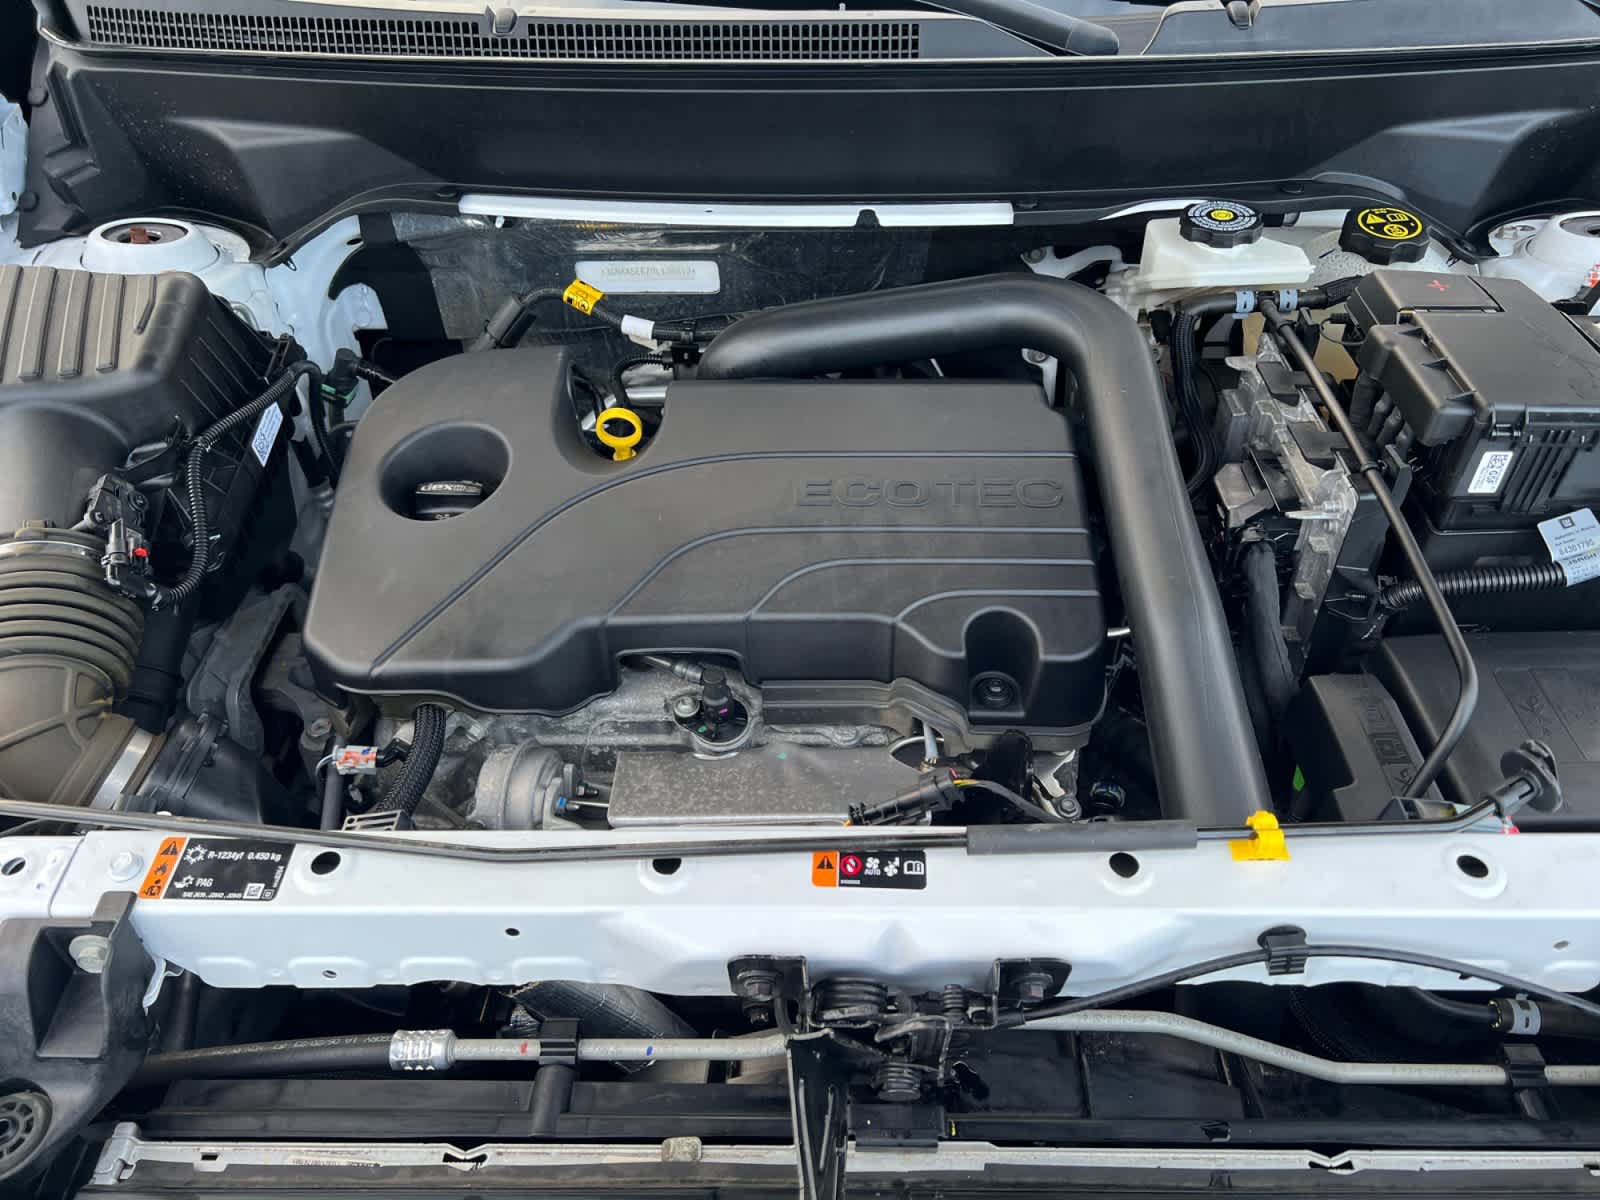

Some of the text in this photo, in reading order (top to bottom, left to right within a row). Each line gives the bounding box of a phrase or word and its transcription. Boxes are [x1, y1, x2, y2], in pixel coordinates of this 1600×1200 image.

[796, 480, 1064, 509] ECOTEC
[270, 852, 282, 862] kg
[864, 868, 881, 876] AUTO
[195, 878, 214, 888] PAG
